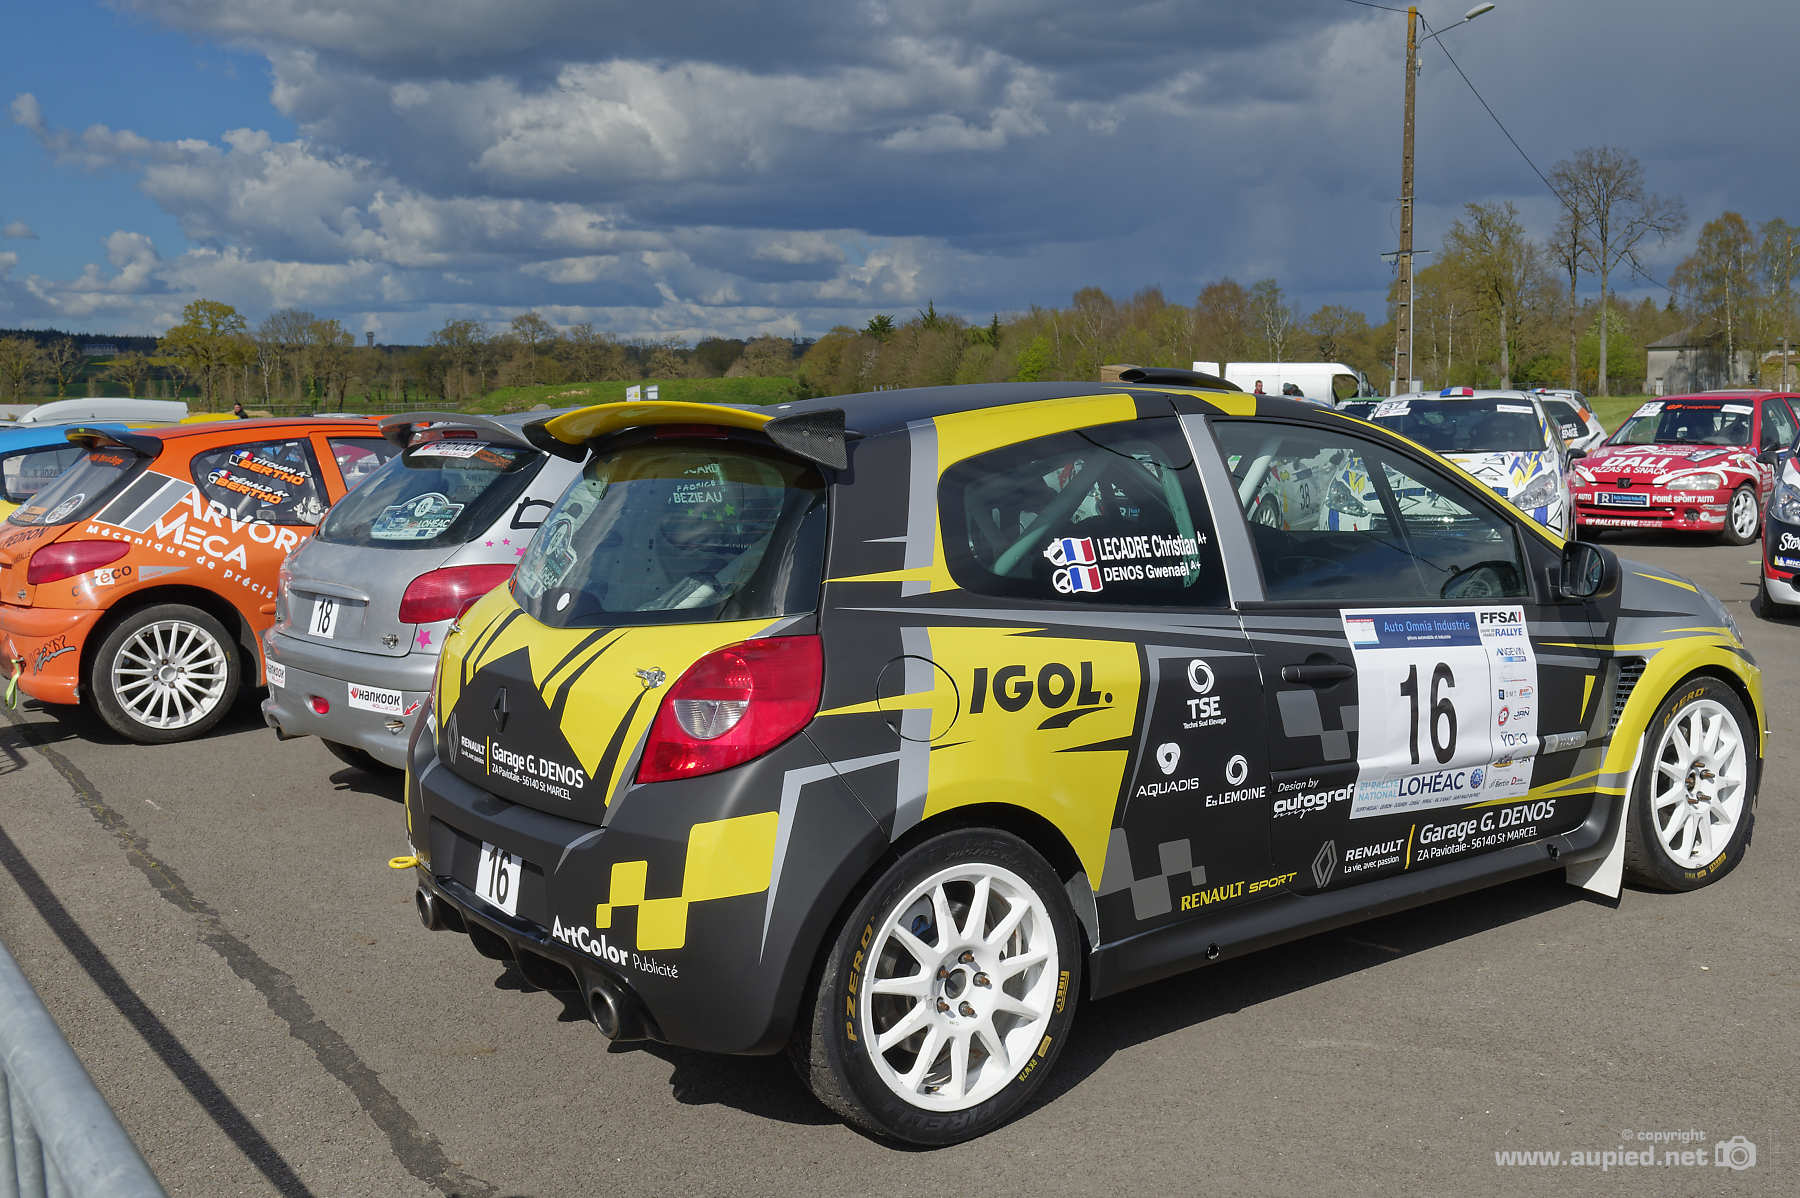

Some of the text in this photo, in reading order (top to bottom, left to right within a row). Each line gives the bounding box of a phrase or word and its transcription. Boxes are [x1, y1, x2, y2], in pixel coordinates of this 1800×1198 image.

[238, 459, 304, 486] BERTHO
[1591, 466, 1623, 474] PIZZAS
[1633, 467, 1669, 475] SNACK
[1601, 456, 1673, 469] DALI
[216, 477, 282, 505] BERTHO
[673, 492, 722, 504] BEZIEAU
[1577, 493, 1592, 501] AUTO
[1601, 493, 1610, 504] R
[1652, 493, 1715, 504] POIRÉ SPORT AUTO
[180, 485, 308, 554] ARVOR
[86, 525, 187, 558] Mécanique
[196, 555, 216, 570] de
[155, 512, 247, 571] MECA
[1097, 531, 1207, 561] LECADRE Christian A+
[1103, 560, 1201, 582] DENOS Gwenaël A+
[317, 598, 333, 634] 18
[1384, 619, 1471, 633] Auto Omnia Industrie
[1480, 612, 1518, 624] FFSA
[1495, 628, 1523, 637] RALLYE
[1186, 696, 1222, 719] TSE
[1400, 662, 1458, 765] 16
[461, 736, 485, 756] RENAULT
[492, 742, 525, 773] Garage
[526, 755, 537, 774] G.
[539, 758, 584, 789] DENOS
[491, 763, 499, 774] ZA
[546, 783, 572, 800] MARCEL
[1136, 778, 1199, 798] AQUADIS
[1278, 778, 1319, 793] Design by
[1398, 771, 1465, 797] LOHÉAC
[1218, 786, 1267, 806] LEMOINE
[1358, 790, 1398, 801] NATIONAL
[1420, 819, 1477, 844] Garage
[1480, 812, 1495, 832] G.
[1499, 799, 1556, 828] DENOS
[1345, 838, 1404, 862] RENAULT
[1417, 849, 1429, 862] ZA
[1471, 835, 1496, 850] 56140
[1497, 833, 1506, 844] St
[1507, 825, 1537, 842] MARCEL
[489, 845, 511, 905] 16
[1344, 865, 1352, 874] La
[1363, 860, 1377, 870] avec
[1377, 855, 1400, 868] passion
[1180, 871, 1298, 912] RENAULT SPORT
[552, 915, 679, 979] ArtColor Publicité
